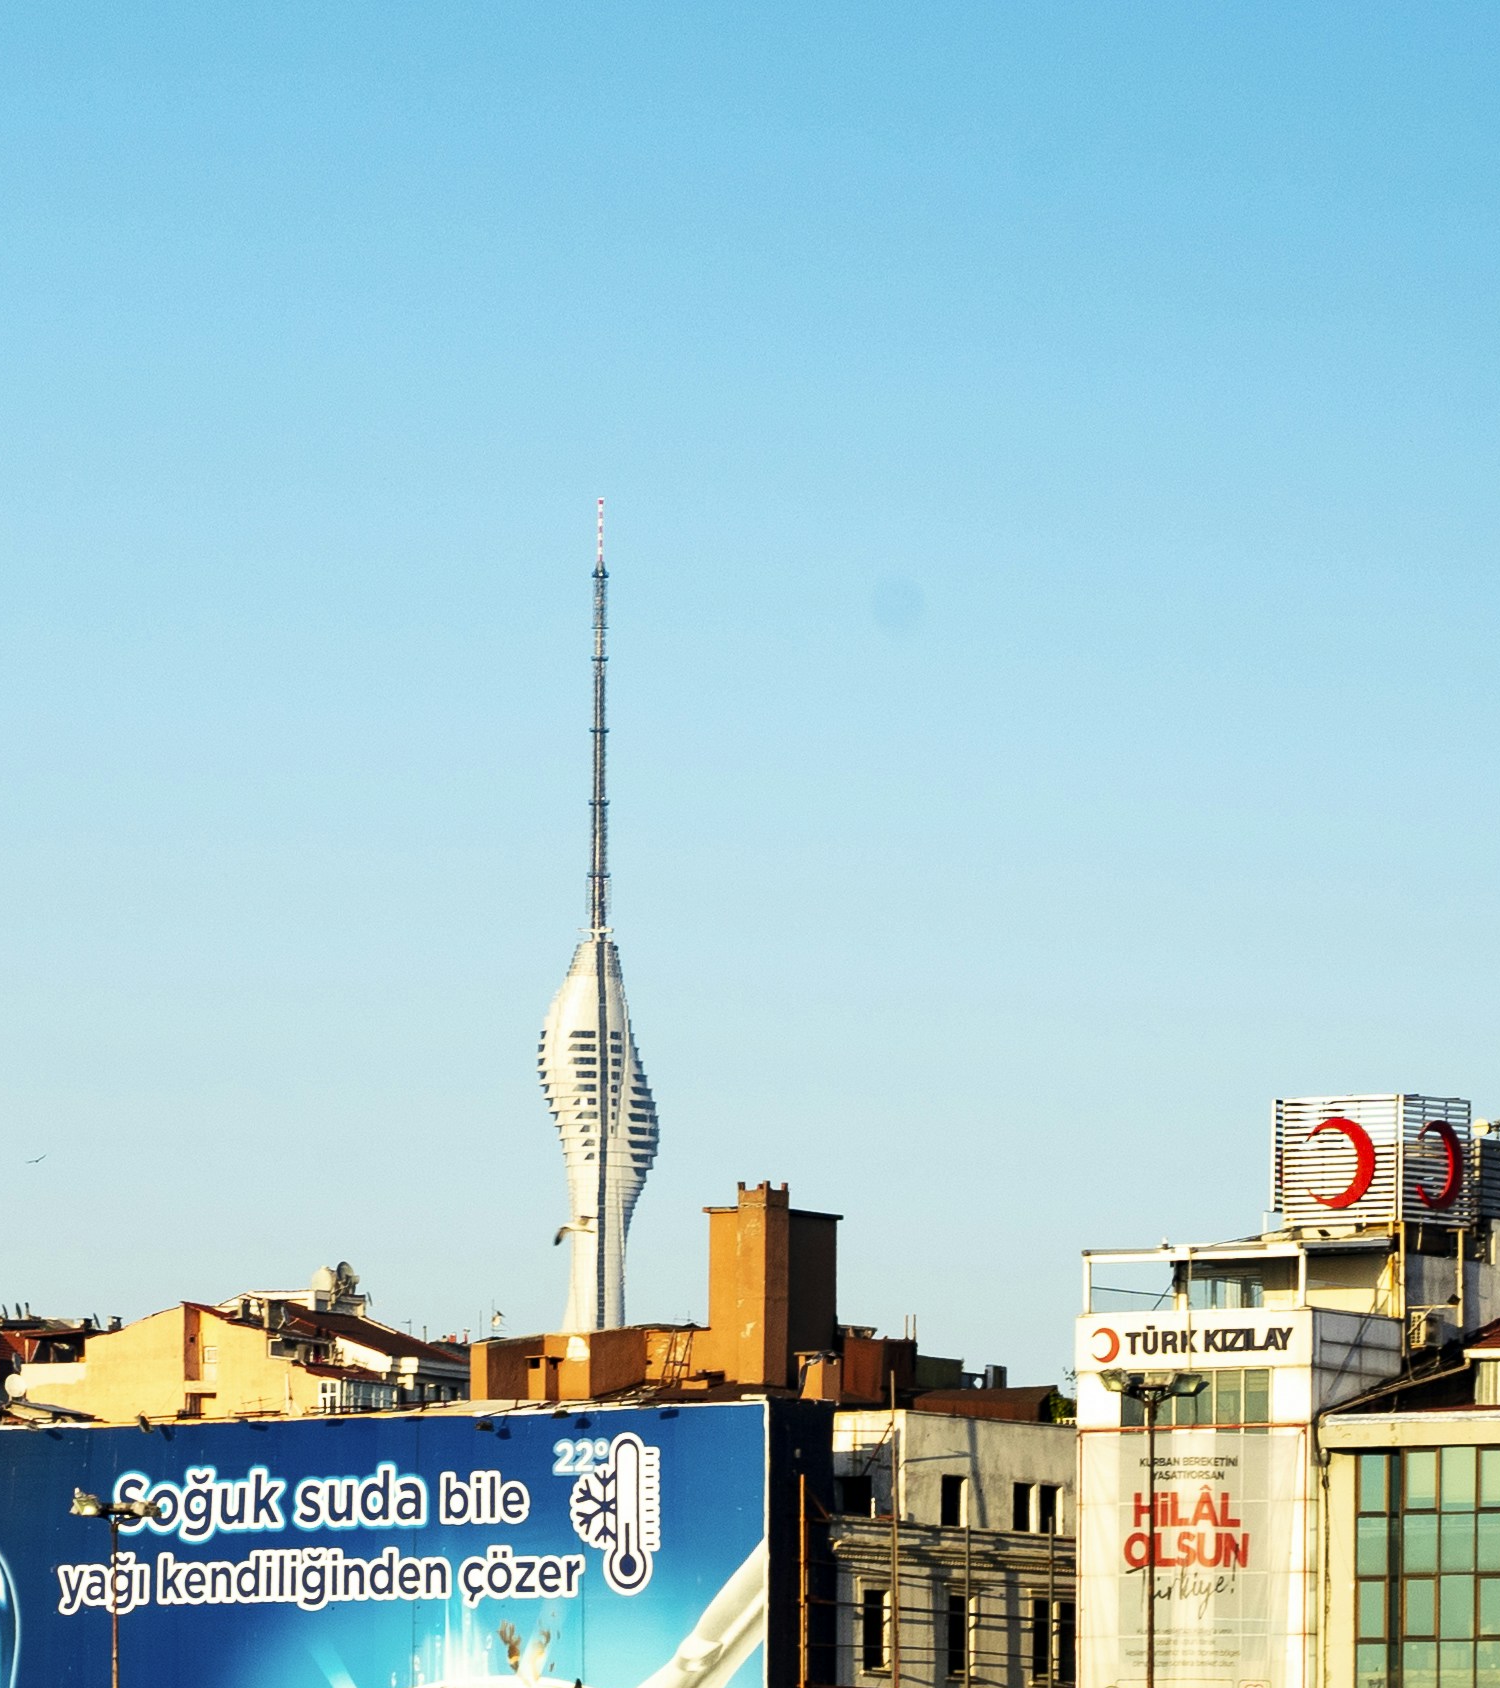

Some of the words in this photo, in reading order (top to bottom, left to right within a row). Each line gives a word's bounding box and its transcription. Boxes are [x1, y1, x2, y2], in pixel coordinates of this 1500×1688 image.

[1125, 1326, 1198, 1355] TÜRK
[1204, 1327, 1294, 1352] KIZILAY
[554, 1440, 608, 1472] 22°
[1139, 1456, 1180, 1467] KURBAN
[1182, 1455, 1239, 1467] BEREKETİNİ
[1152, 1470, 1225, 1481] YAŞATIYORSAN
[119, 1473, 283, 1537] Soğuk
[300, 1466, 425, 1524] suda
[443, 1473, 527, 1522] bile
[1123, 1531, 1250, 1568] OLSUN
[61, 1555, 147, 1610] yağı
[163, 1549, 447, 1606] kendiliğinden
[464, 1549, 581, 1604] çözer
